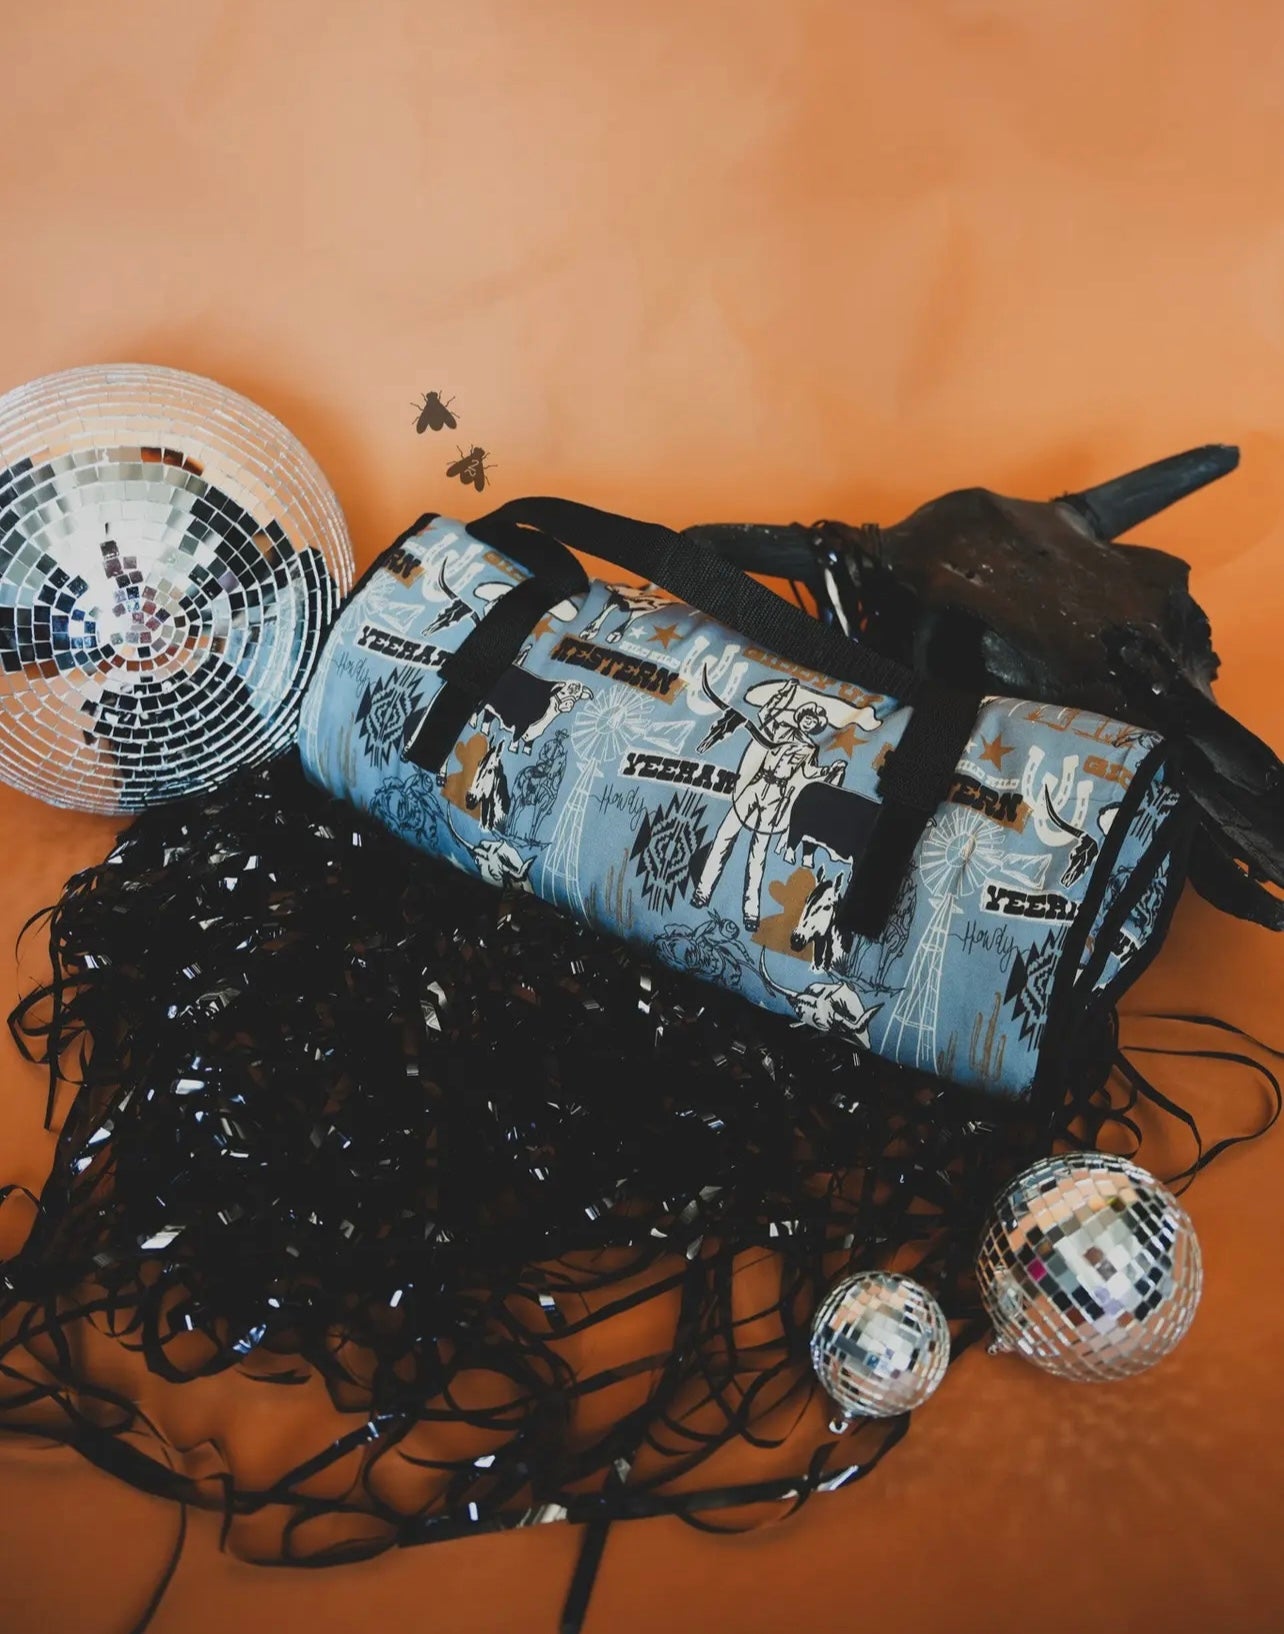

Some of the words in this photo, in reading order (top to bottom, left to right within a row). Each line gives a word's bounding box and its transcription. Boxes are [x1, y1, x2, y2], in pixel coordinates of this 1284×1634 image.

[623, 752, 740, 794] YEEHAW
[1083, 755, 1134, 790] GID
[592, 784, 650, 831] Howdy
[986, 885, 1078, 921] YEEH
[953, 920, 1024, 973] Howdy
